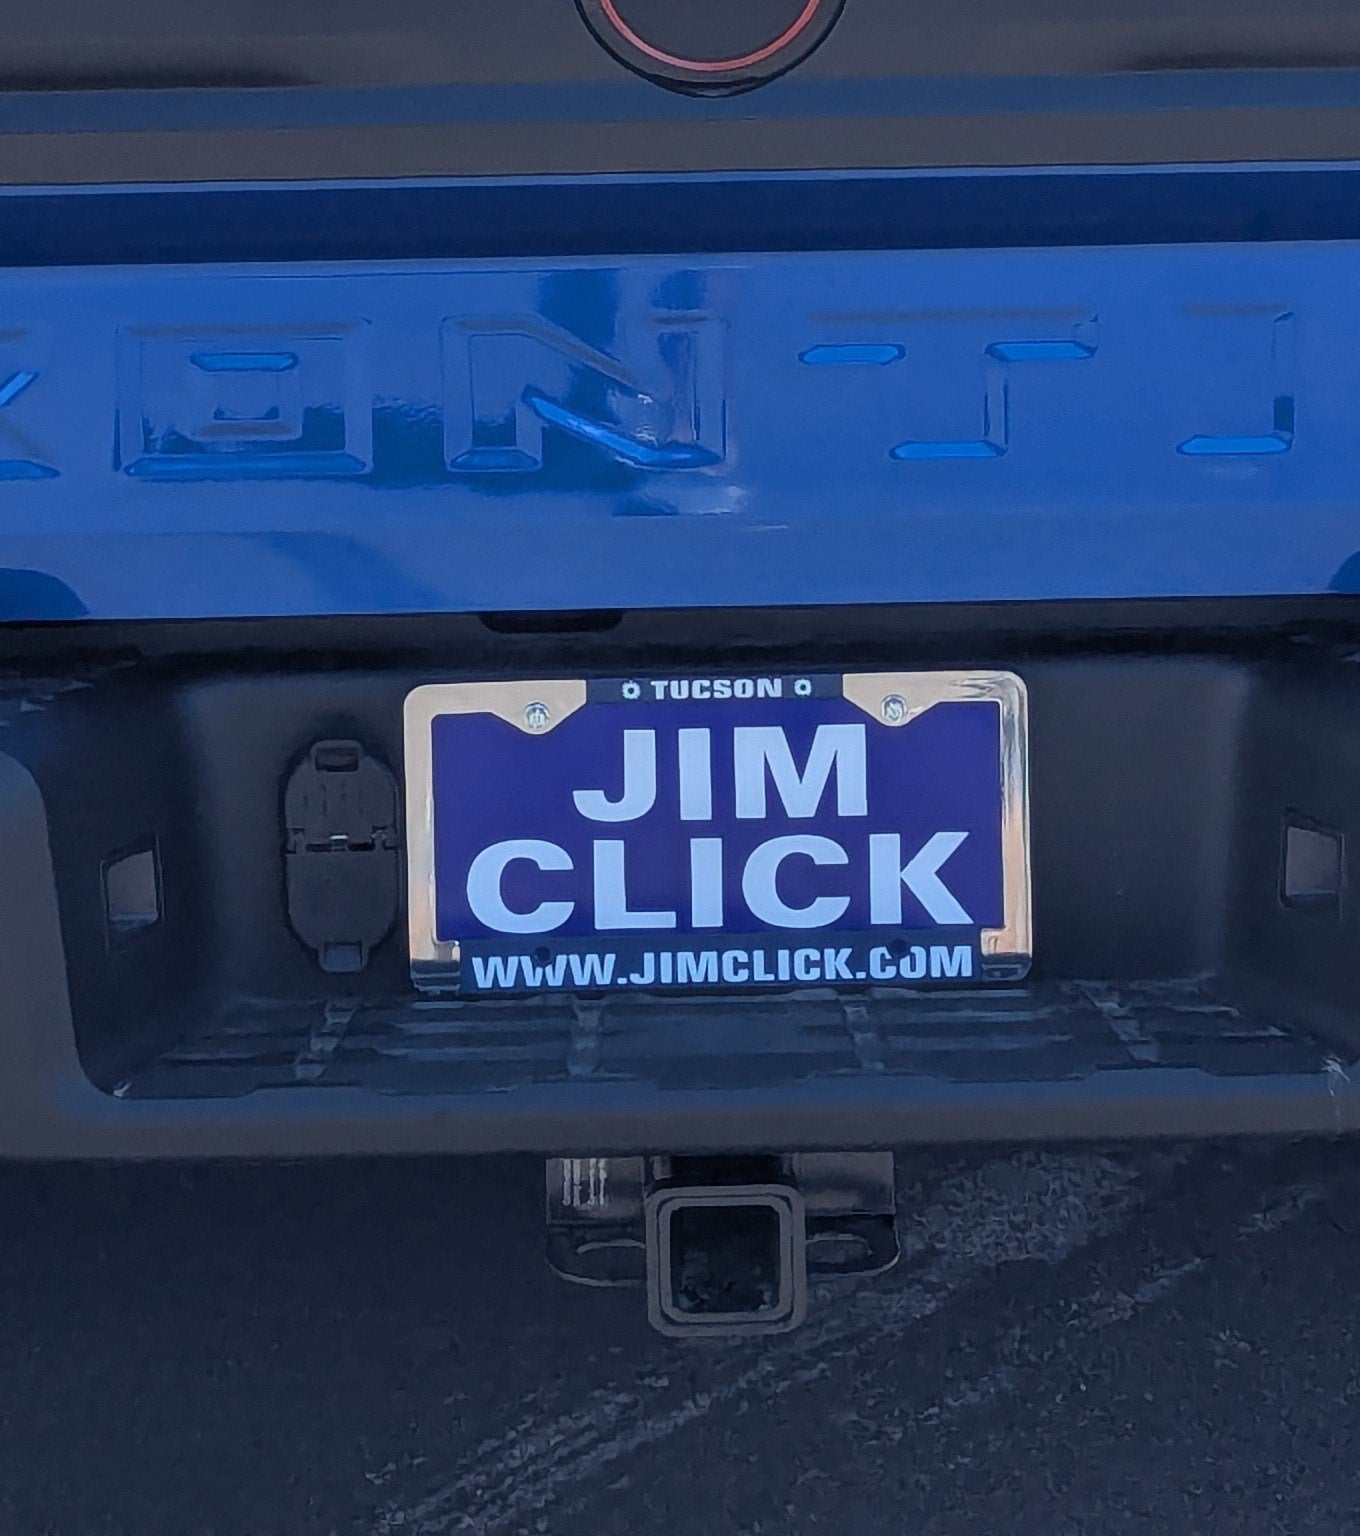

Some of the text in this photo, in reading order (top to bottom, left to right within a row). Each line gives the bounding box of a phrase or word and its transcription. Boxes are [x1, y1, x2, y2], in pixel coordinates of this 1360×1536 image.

[650, 676, 783, 701] TUCSON
[572, 723, 869, 823] JIM
[466, 831, 974, 934] CLICK
[471, 944, 974, 989] WWW.JIMCLICK.COM
